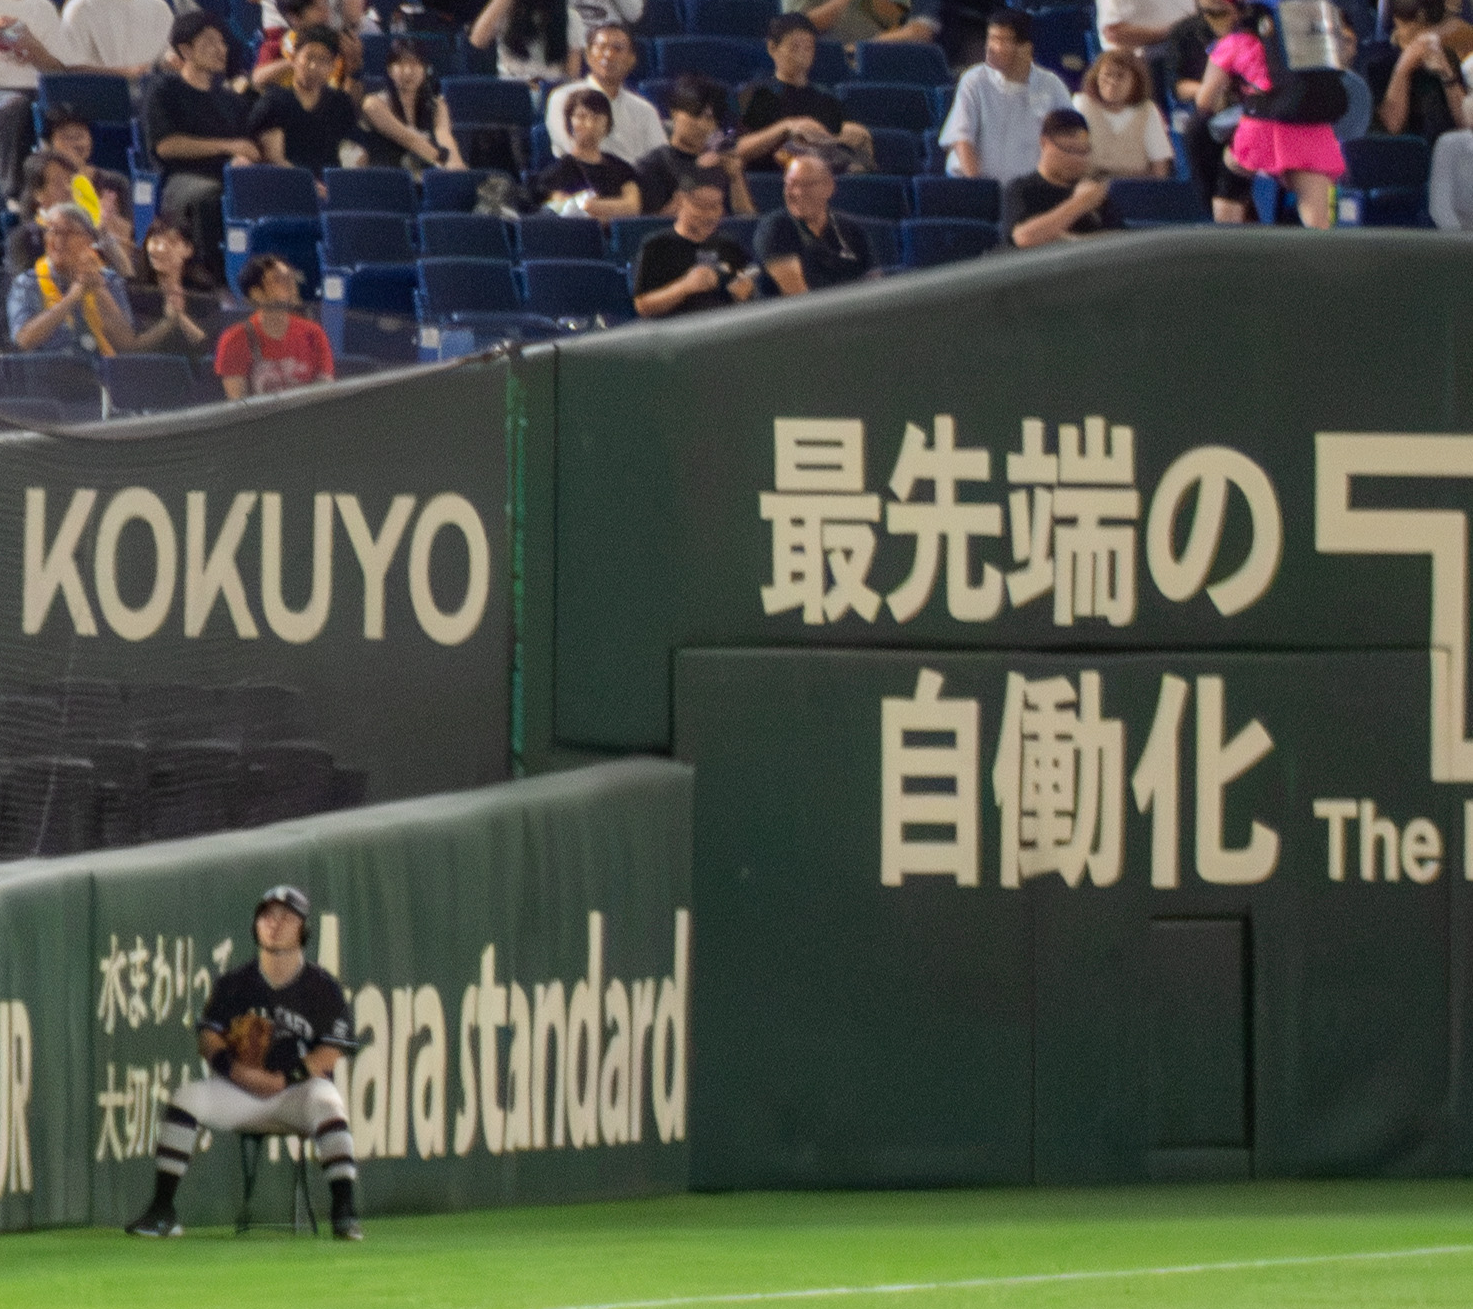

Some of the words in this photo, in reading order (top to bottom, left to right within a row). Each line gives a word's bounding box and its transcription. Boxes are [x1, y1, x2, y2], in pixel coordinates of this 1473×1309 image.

[21, 485, 492, 644] KOKUYO
[760, 414, 1284, 627] 最先端の
[879, 669, 1279, 889] 自働化
[1312, 797, 1444, 885] The
[453, 908, 692, 1157] standard
